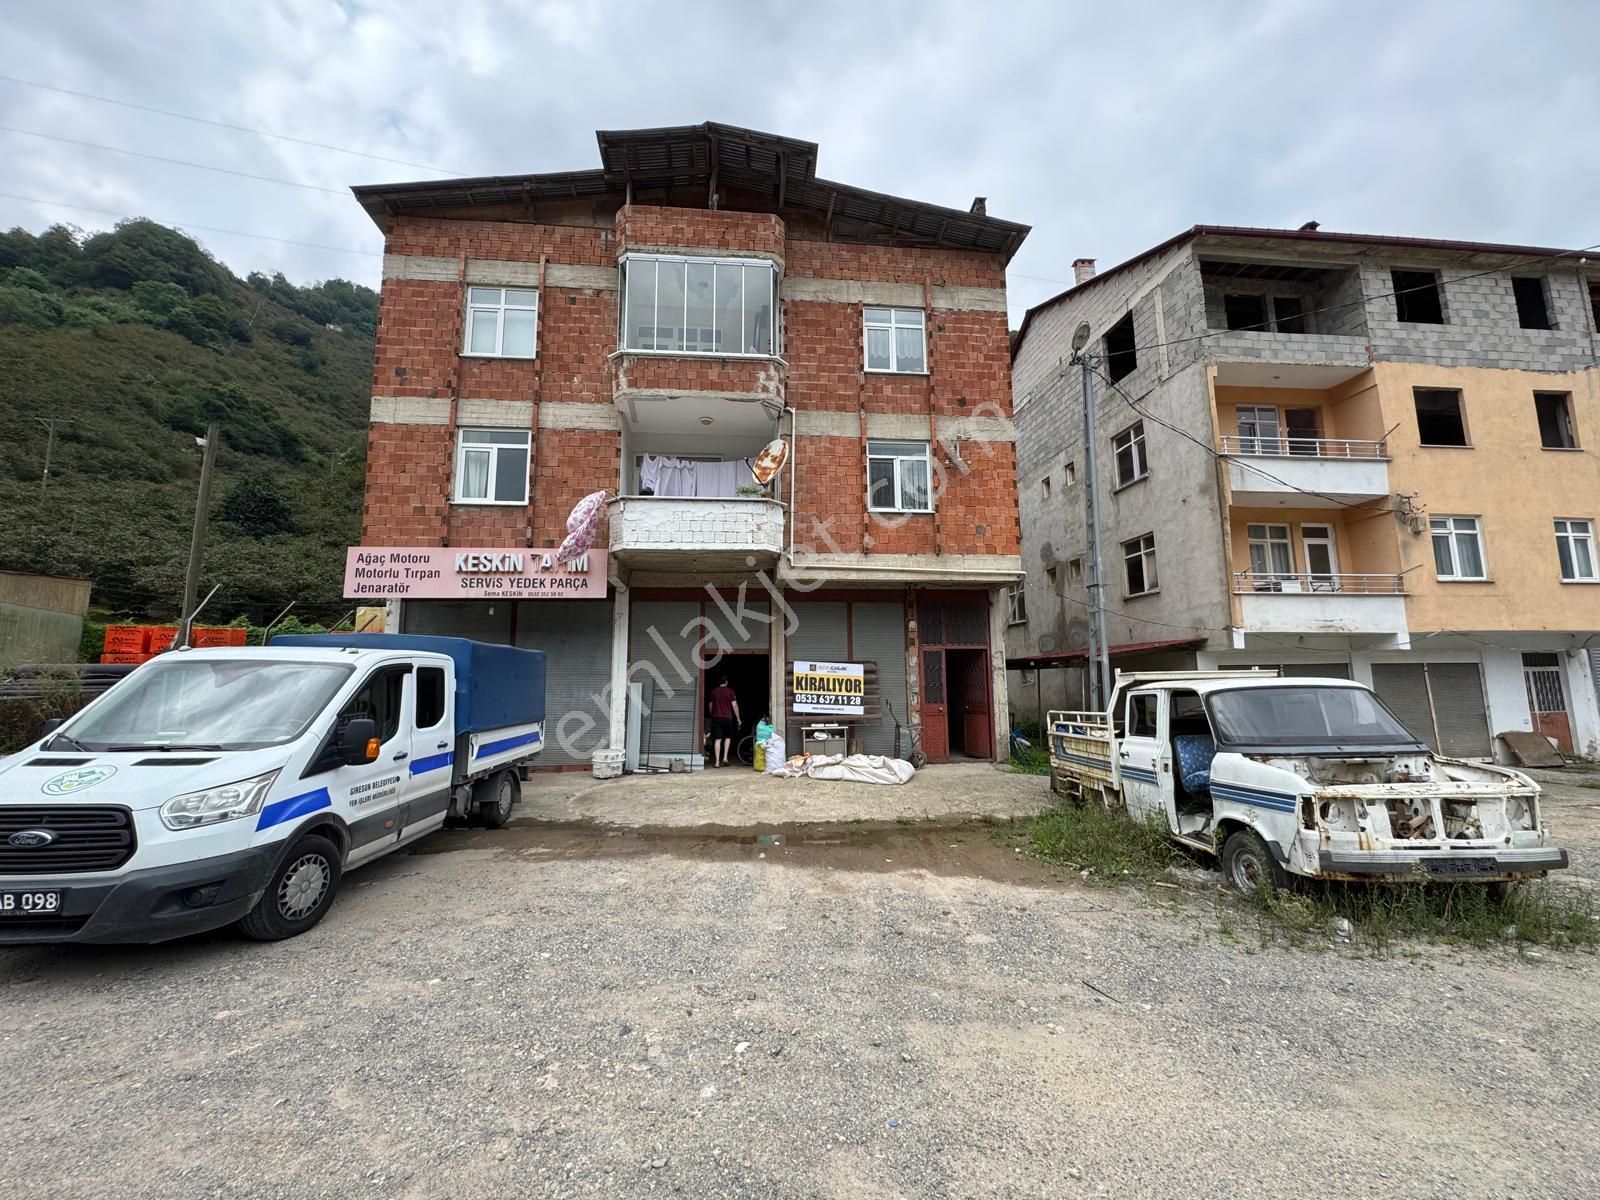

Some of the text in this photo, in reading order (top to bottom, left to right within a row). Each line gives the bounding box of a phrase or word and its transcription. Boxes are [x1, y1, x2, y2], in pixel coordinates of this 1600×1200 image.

[356, 553, 430, 566] Ağaç Motoru
[354, 567, 441, 581] Motorlu Tırpan
[353, 582, 411, 593] Jenaratör
[508, 577, 546, 589] YEDEK
[550, 577, 589, 591] PARÇA
[795, 674, 862, 693] KİRALIYOR
[795, 693, 861, 705] 0533 637 11 28
[14, 833, 40, 845] Ford
[0, 893, 57, 910] B 098
